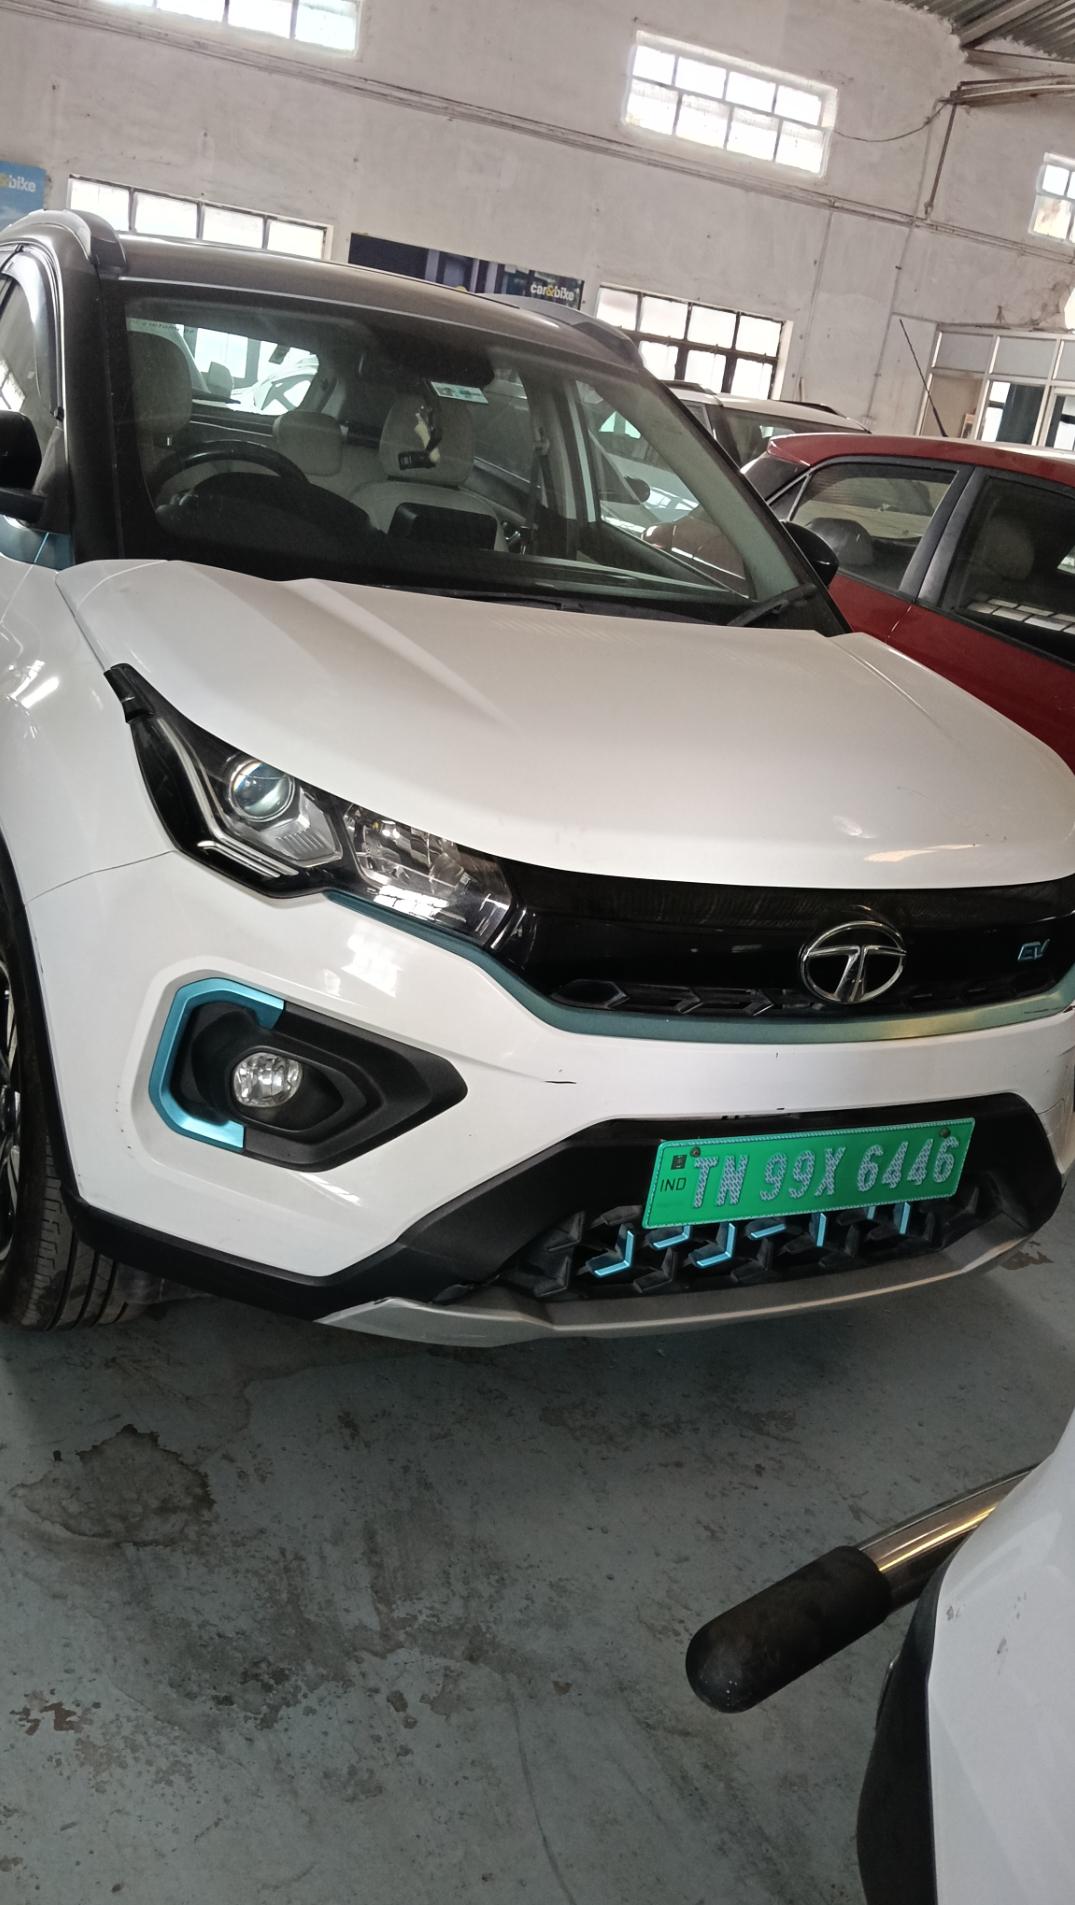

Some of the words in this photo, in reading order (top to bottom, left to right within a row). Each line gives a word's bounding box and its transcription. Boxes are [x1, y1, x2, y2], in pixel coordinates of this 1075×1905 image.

[530, 284, 575, 301] car&bike
[1017, 939, 1051, 961] EV
[693, 1154, 750, 1208] TN
[760, 1146, 847, 1201] 99X
[857, 1135, 960, 1192] 6446
[660, 1177, 687, 1193] IND
